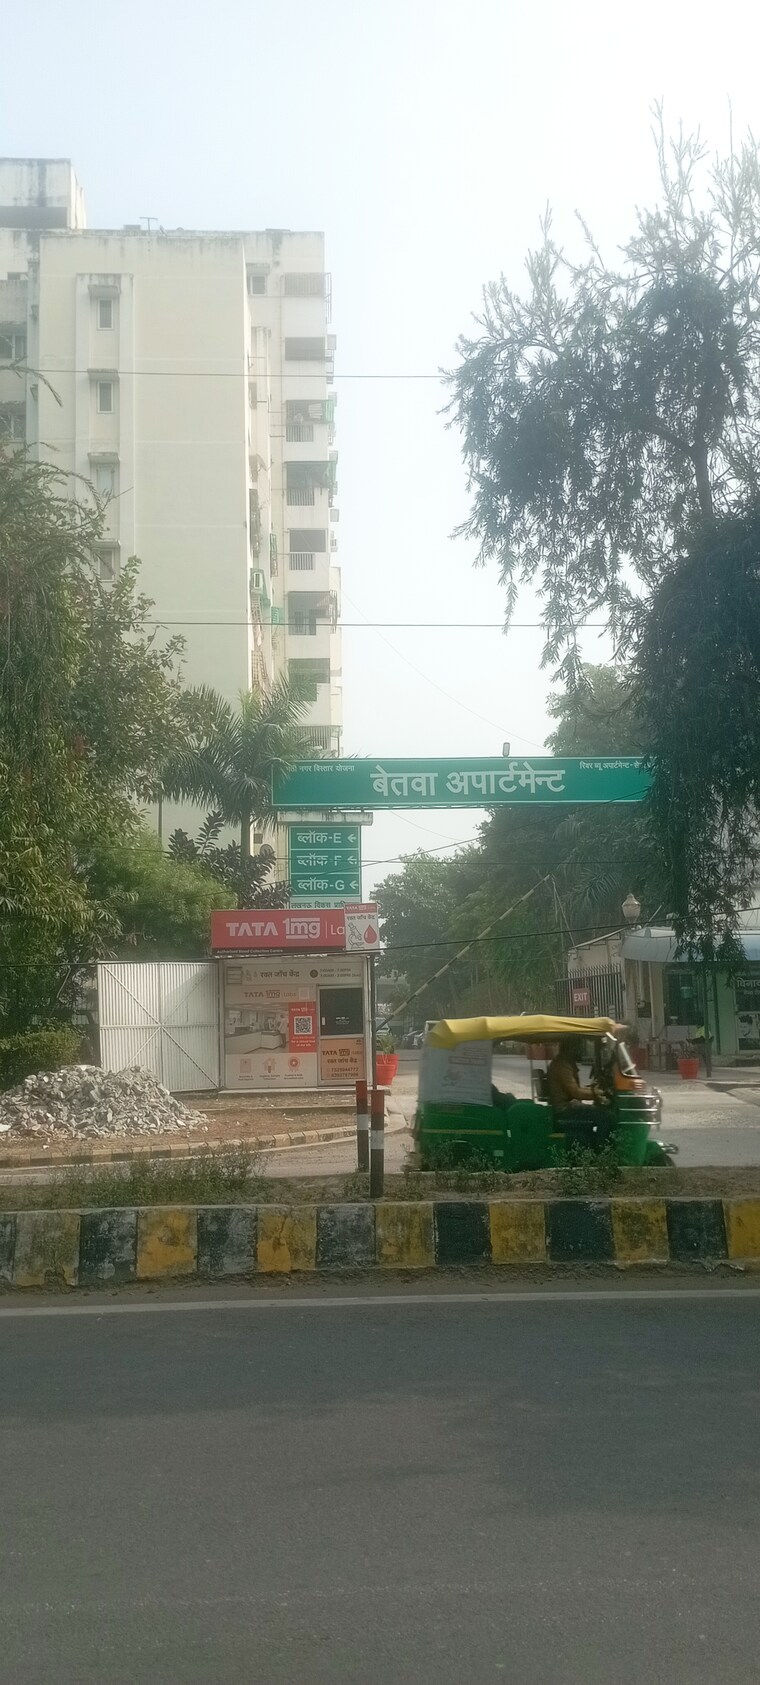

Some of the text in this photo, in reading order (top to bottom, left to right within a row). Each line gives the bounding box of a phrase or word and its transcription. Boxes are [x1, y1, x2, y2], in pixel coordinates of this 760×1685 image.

[313, 763, 333, 772] विस्तार
[335, 764, 355, 772] योजना
[369, 761, 566, 797] बेतवा अपार्टमेन्ट
[296, 830, 342, 844] ब्लॉक-E
[297, 877, 345, 891] ब्लॉक-G
[225, 917, 345, 940] TATA 1mg La
[573, 992, 588, 1002] EXIT
